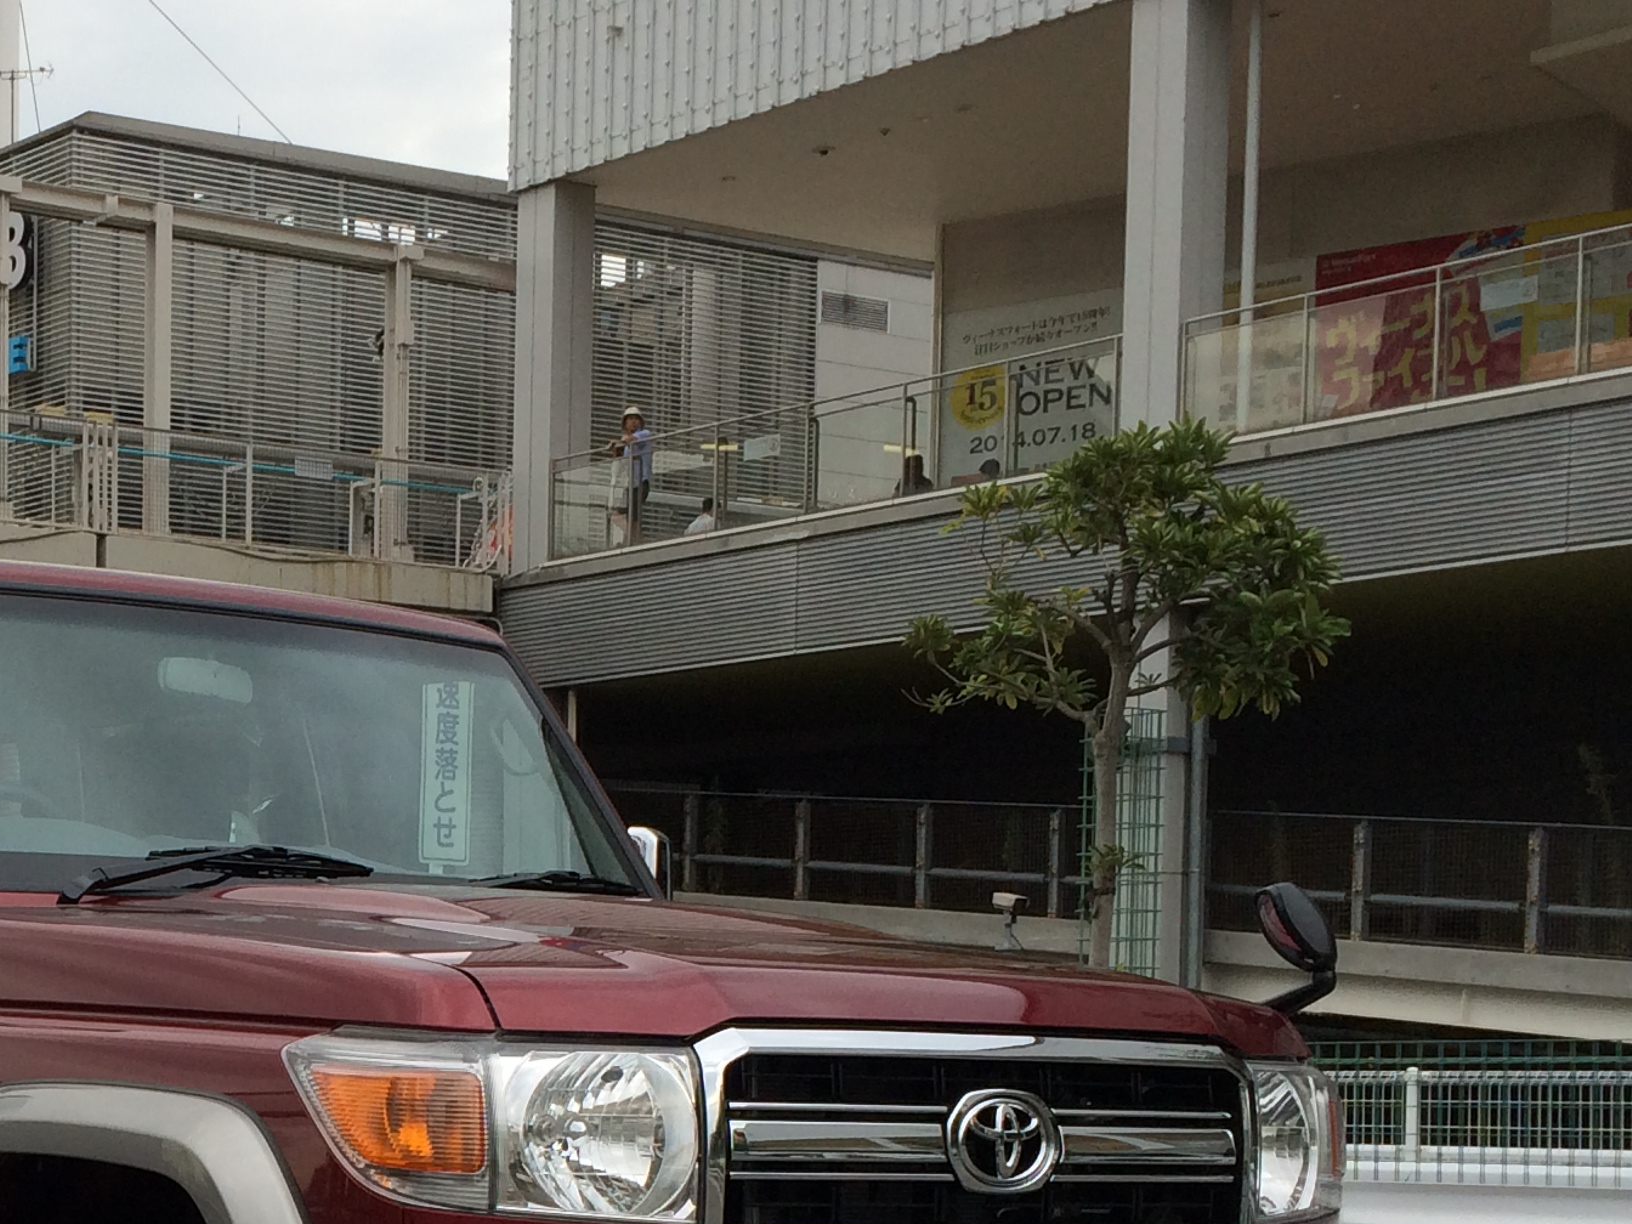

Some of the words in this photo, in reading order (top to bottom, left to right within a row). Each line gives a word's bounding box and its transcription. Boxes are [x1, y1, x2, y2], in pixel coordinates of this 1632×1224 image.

[1018, 356, 1100, 389] NEW
[965, 379, 998, 411] 15
[1017, 381, 1113, 416] OPEN
[969, 421, 1097, 455] 204.07.18
[432, 680, 461, 849] 速度落とせ
